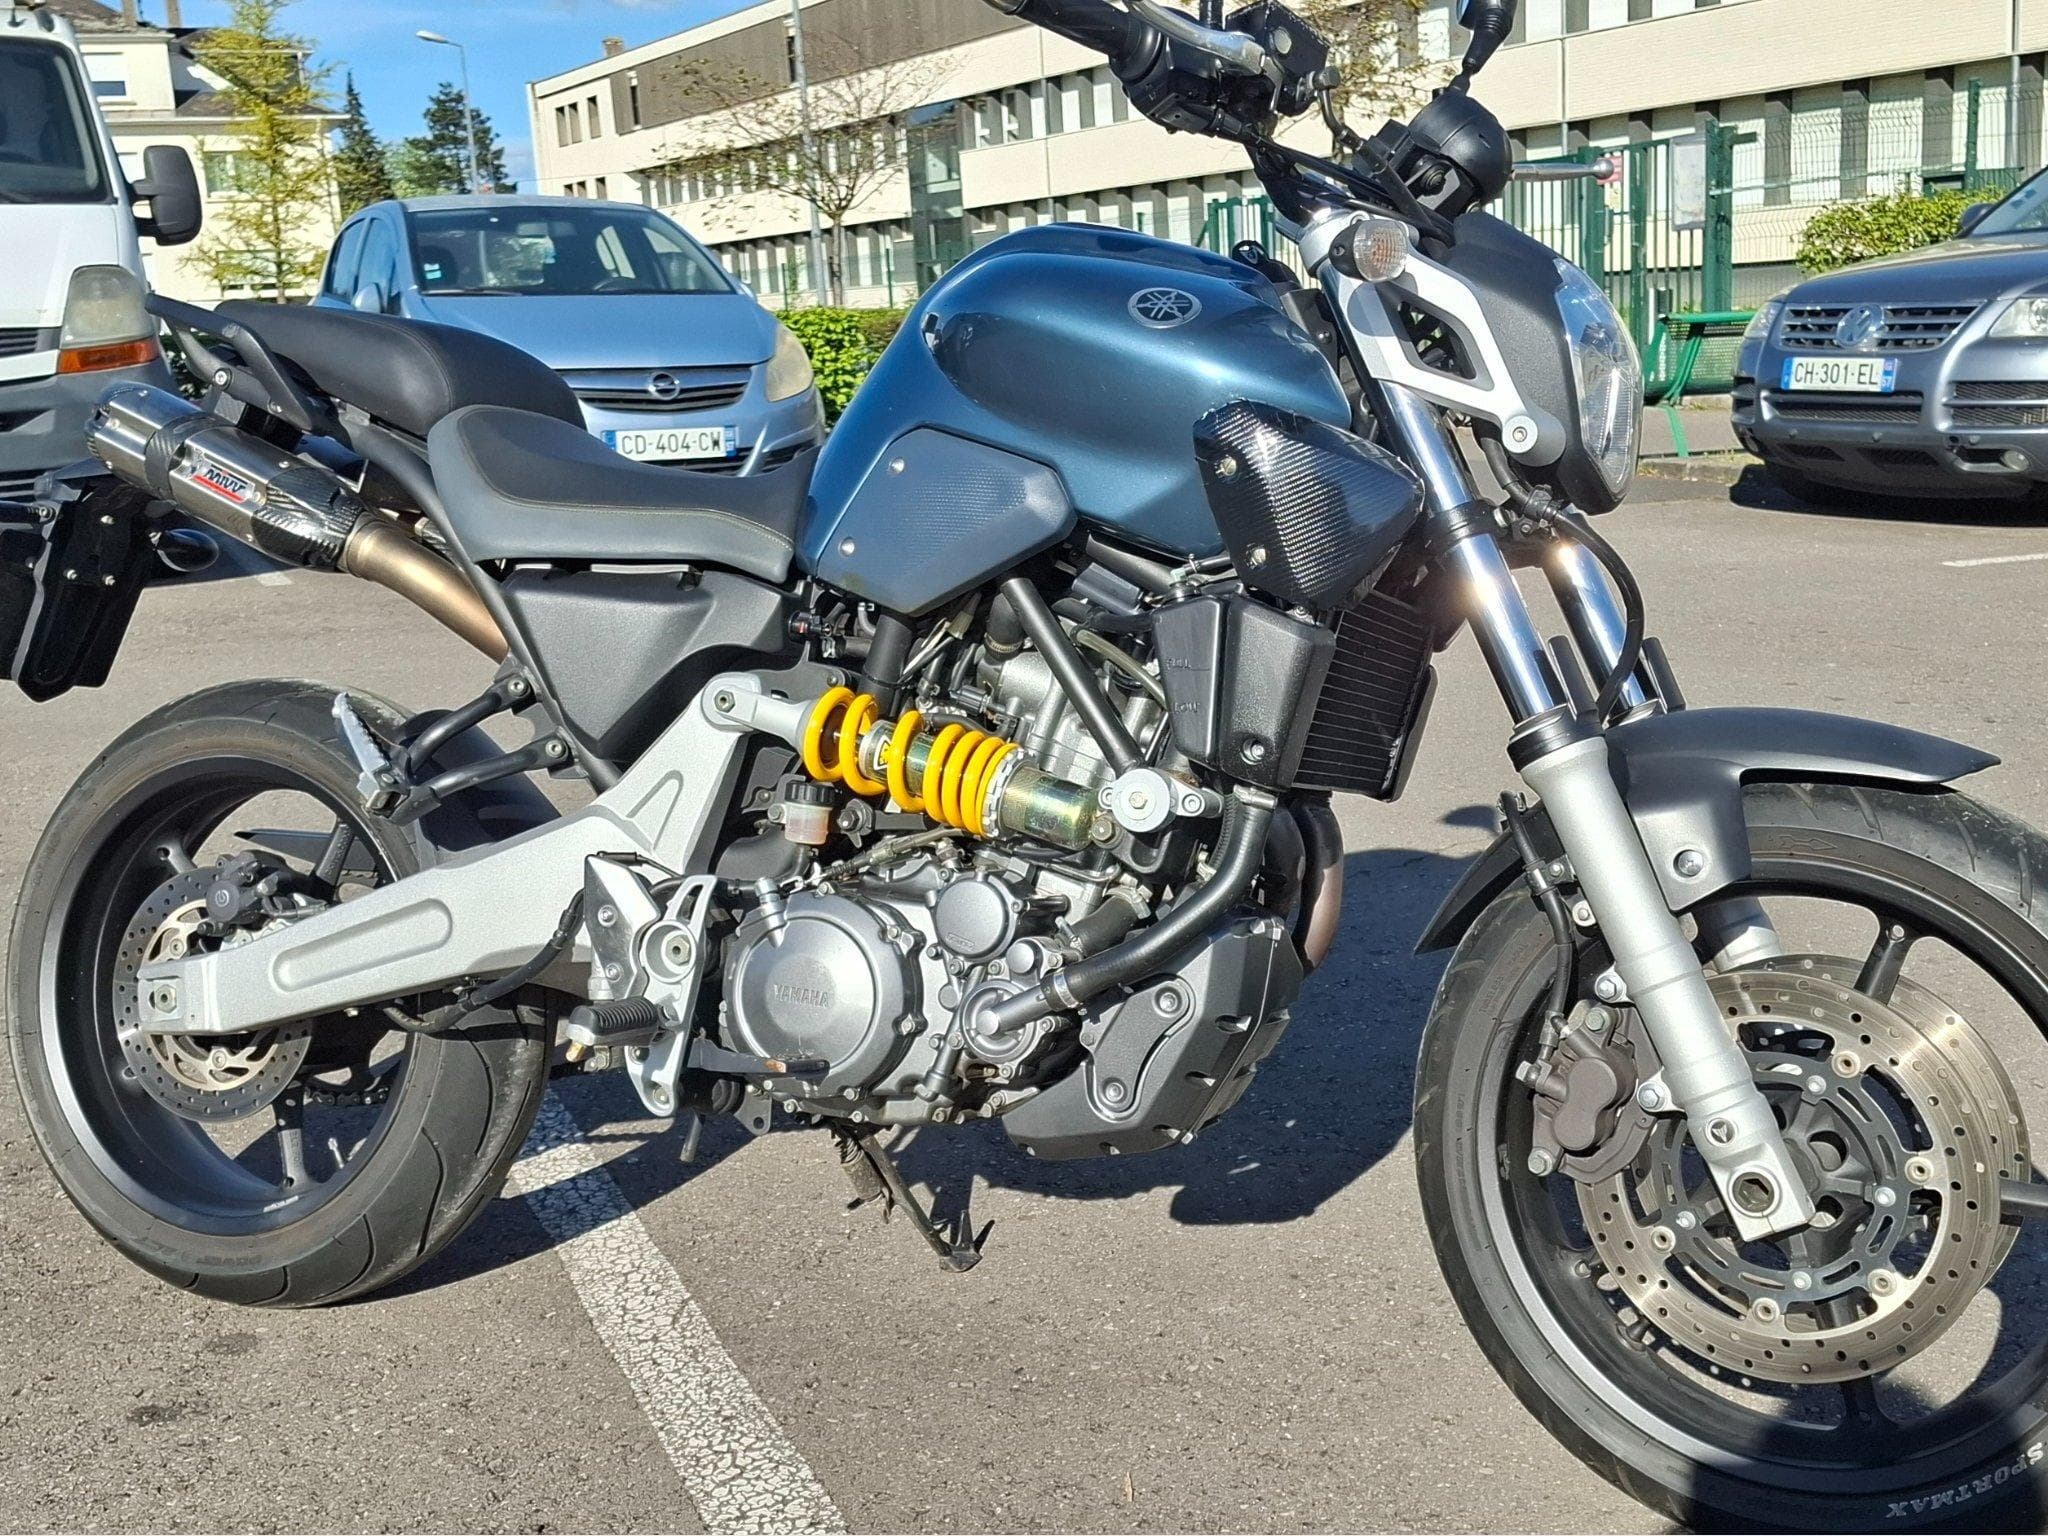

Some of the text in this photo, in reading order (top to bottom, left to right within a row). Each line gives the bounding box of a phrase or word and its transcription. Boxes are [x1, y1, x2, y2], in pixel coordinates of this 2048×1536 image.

[1794, 363, 1879, 386] CH-301-EL
[621, 431, 721, 455] CD-404-CW
[773, 984, 830, 1008] YAMAHA
[1885, 1441, 2045, 1519] SPORTMAX
